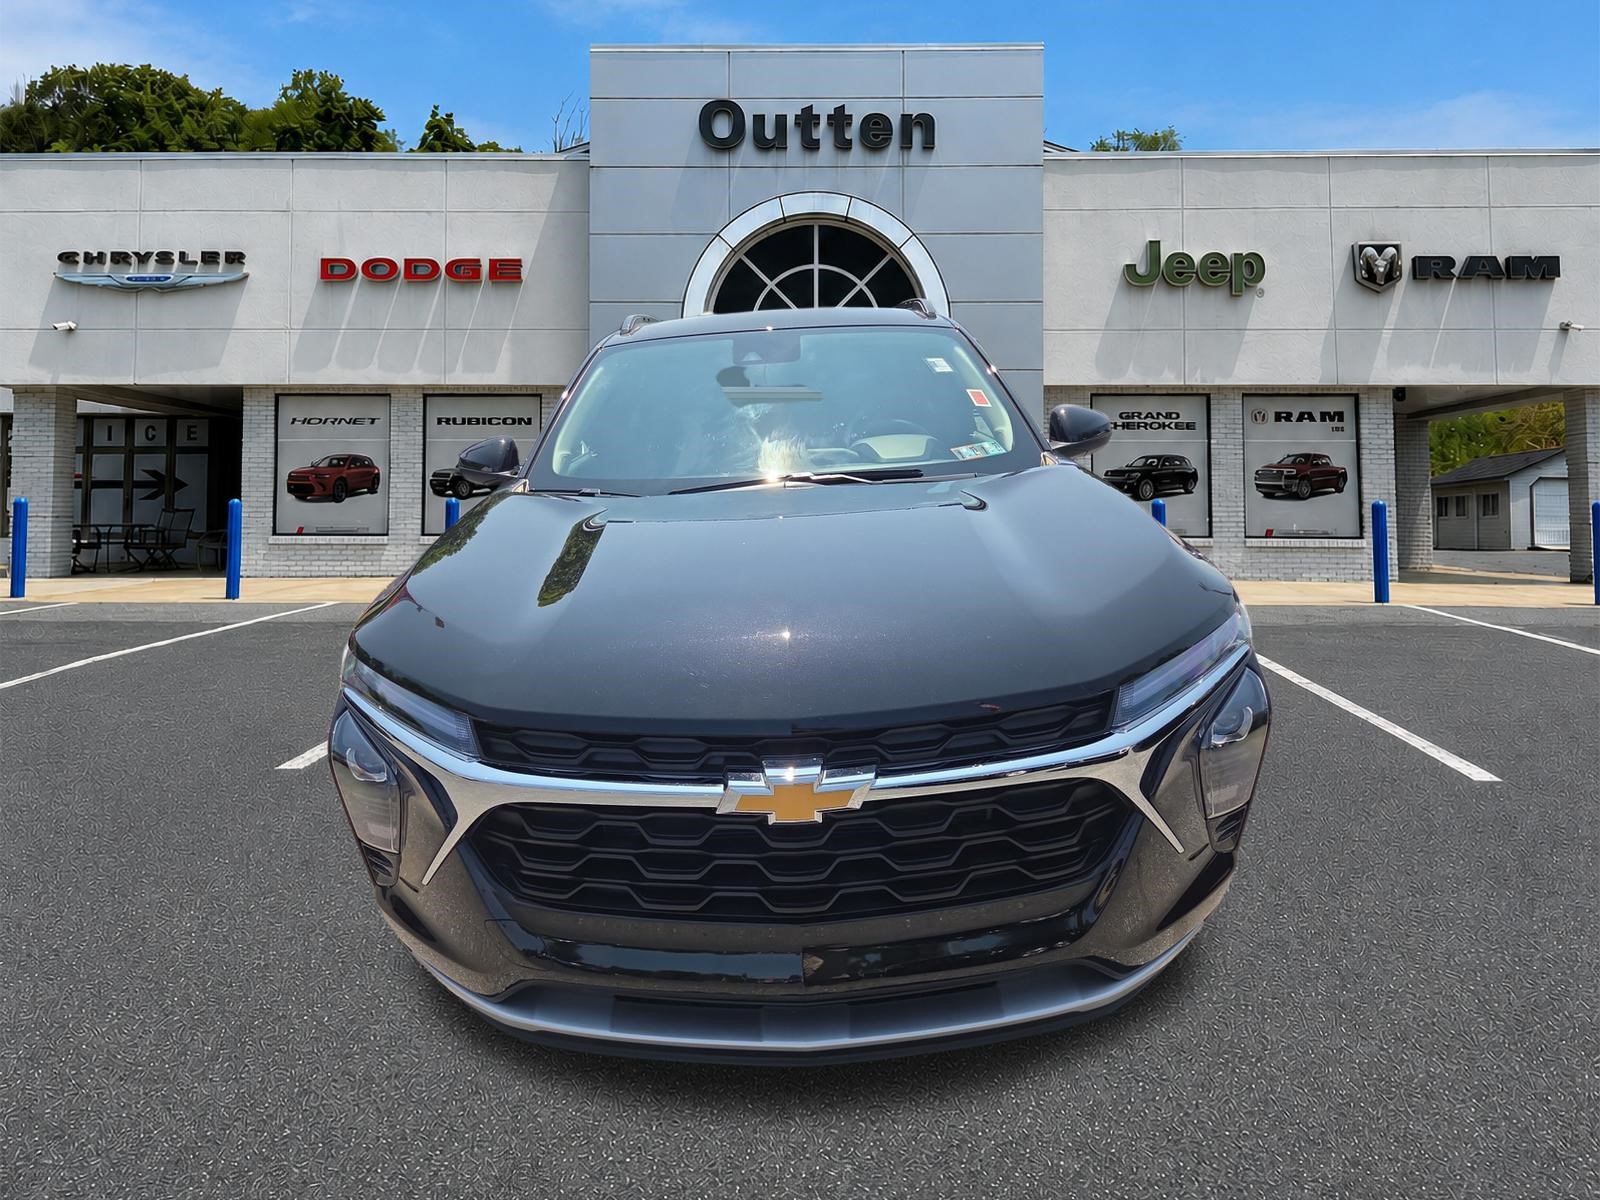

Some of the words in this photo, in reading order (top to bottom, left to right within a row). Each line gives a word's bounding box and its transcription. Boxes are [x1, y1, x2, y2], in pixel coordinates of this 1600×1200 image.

[698, 99, 935, 150] Outten
[57, 250, 247, 266] CHRYSLER
[320, 257, 523, 282] DODGE
[1123, 239, 1266, 296] Jeep
[1411, 254, 1561, 280] RAM
[290, 417, 381, 426] HORNET
[436, 416, 533, 426] RUBICON
[1118, 411, 1181, 420] GRAND
[1274, 411, 1345, 423] RAM
